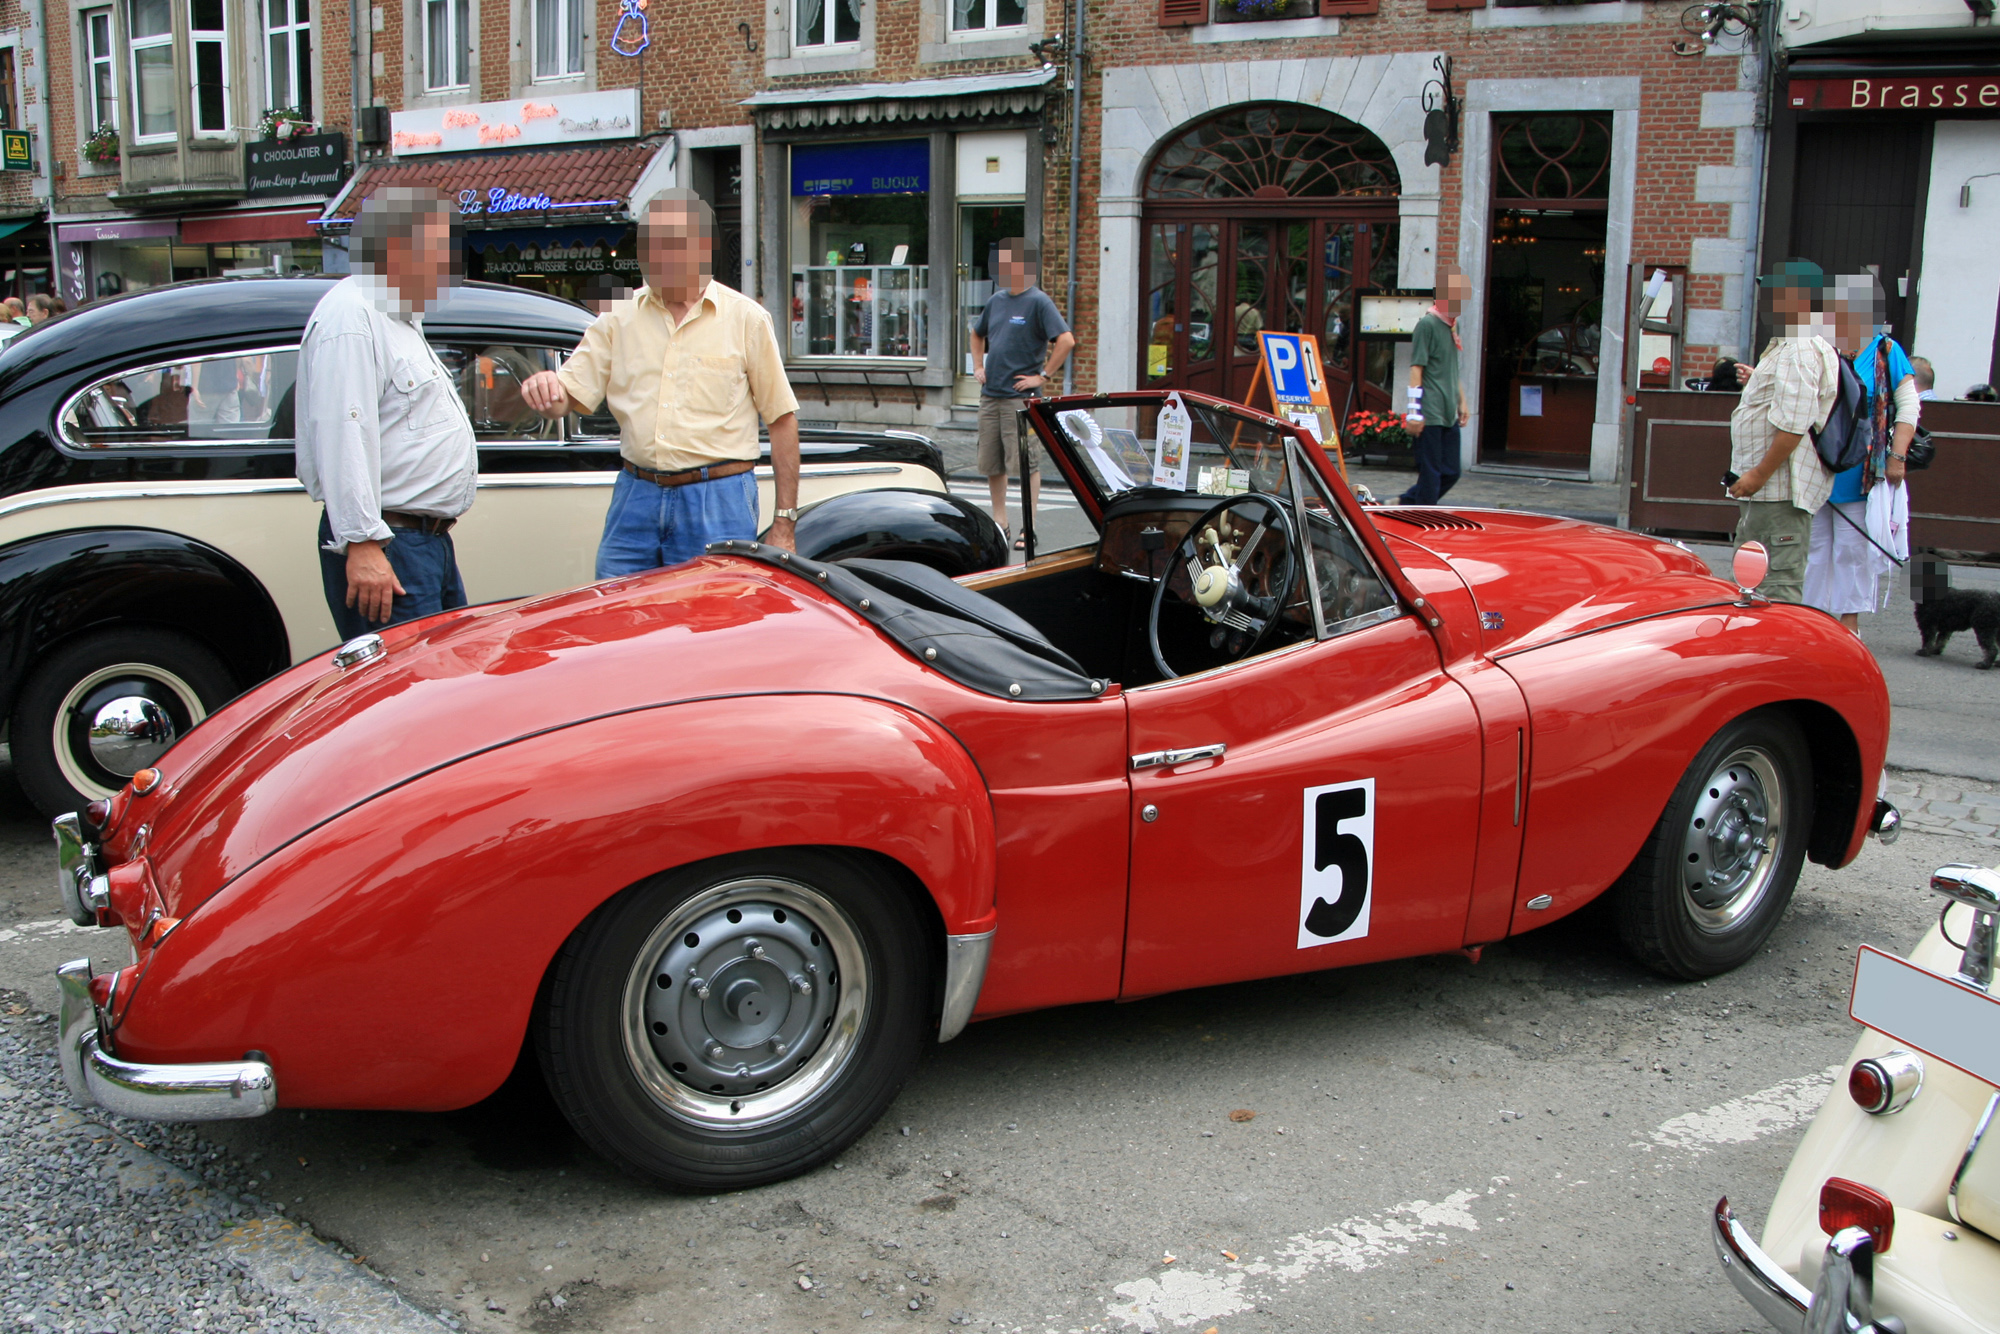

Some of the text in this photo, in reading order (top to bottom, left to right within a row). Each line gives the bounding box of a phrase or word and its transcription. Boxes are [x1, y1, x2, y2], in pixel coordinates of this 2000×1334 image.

[1851, 79, 2000, 108] Brasse
[263, 146, 320, 162] CHOCOLATIER
[299, 168, 340, 186] Legrand
[803, 176, 920, 192] GIPSY BIJOUX
[458, 187, 551, 214] La Gâterie
[486, 261, 527, 273] TEA-ROOM
[533, 261, 568, 272] PATISSERIE
[574, 260, 605, 271] GLACES
[1379, 289, 1417, 297] MENU
[1267, 337, 1298, 391] P
[1304, 787, 1369, 938] 5
